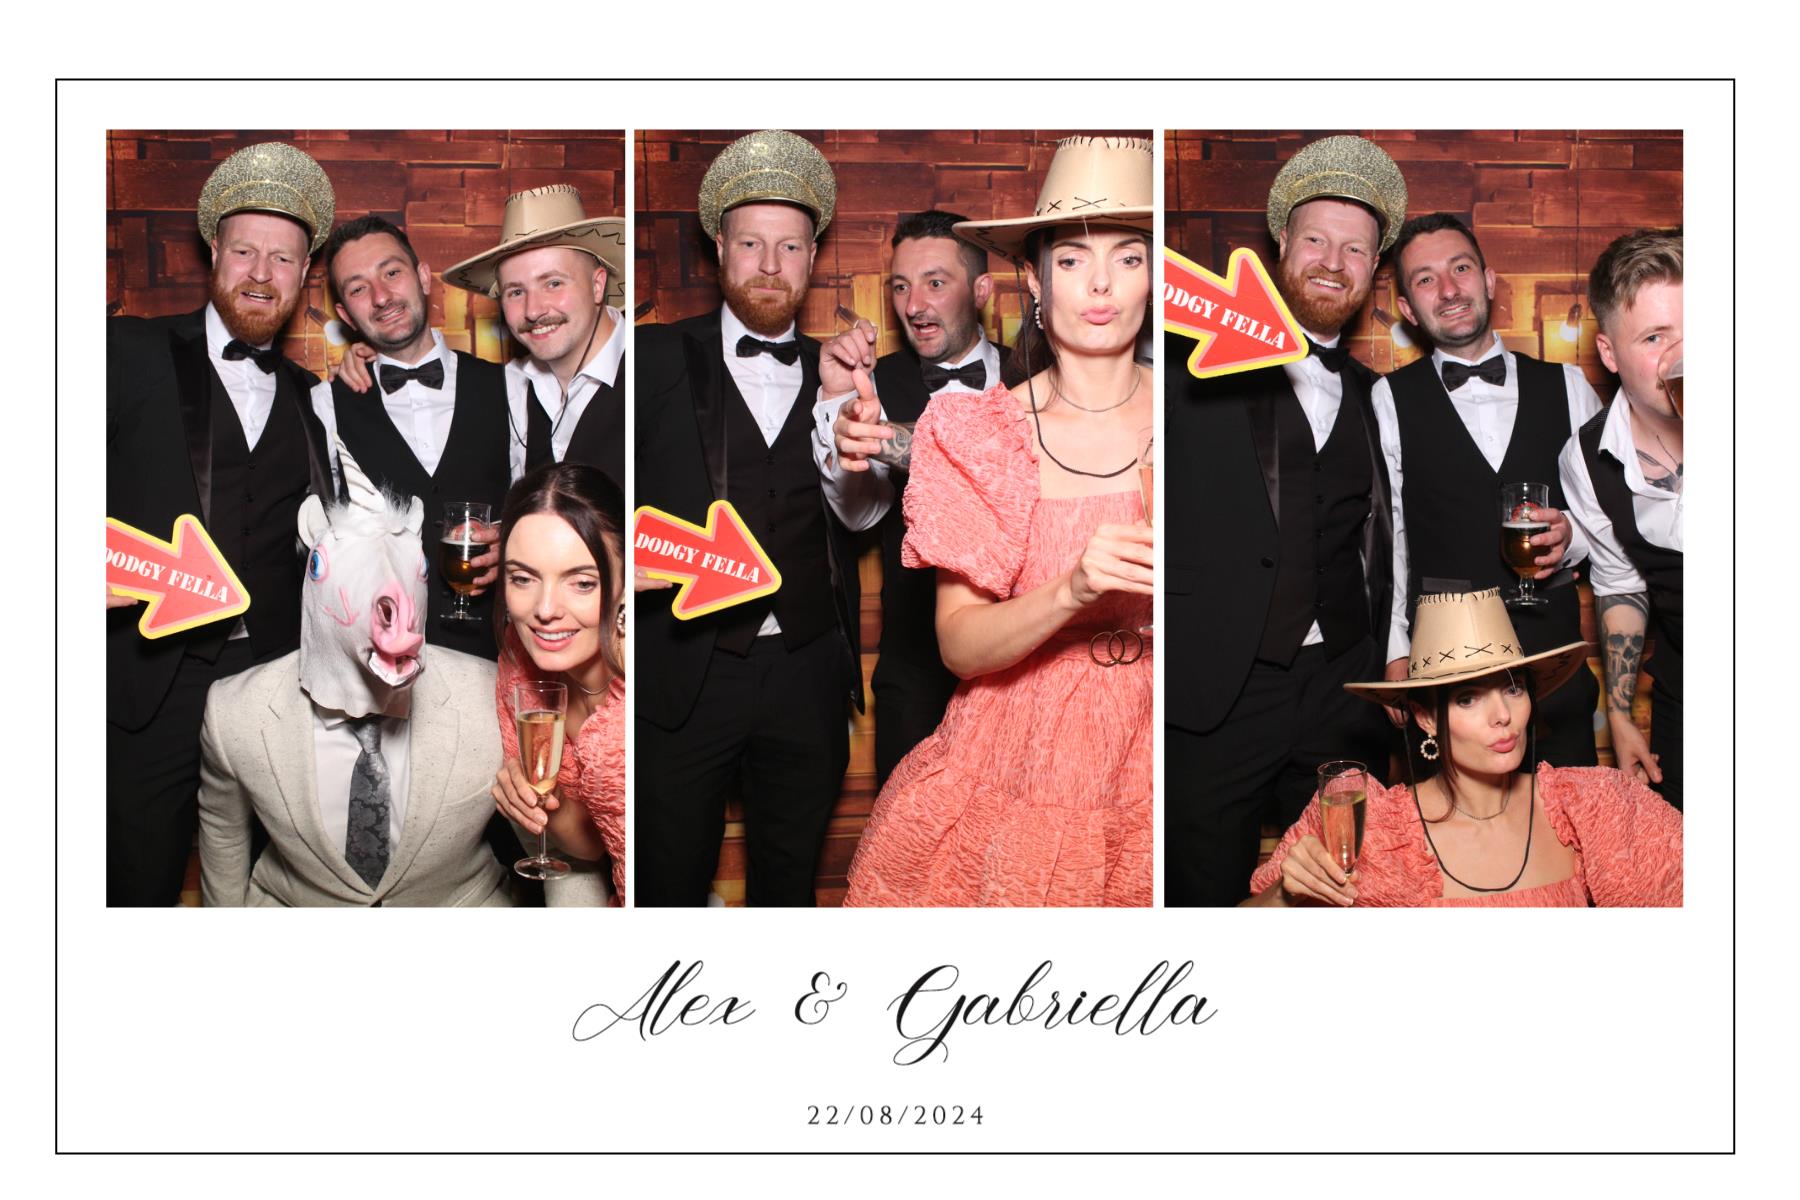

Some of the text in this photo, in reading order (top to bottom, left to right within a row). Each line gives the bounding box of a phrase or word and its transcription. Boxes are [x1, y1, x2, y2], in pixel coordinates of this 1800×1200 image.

[1164, 283, 1286, 349] ODGY FELLA
[634, 533, 760, 584] DODGY FELLA
[167, 569, 228, 603] FELLA
